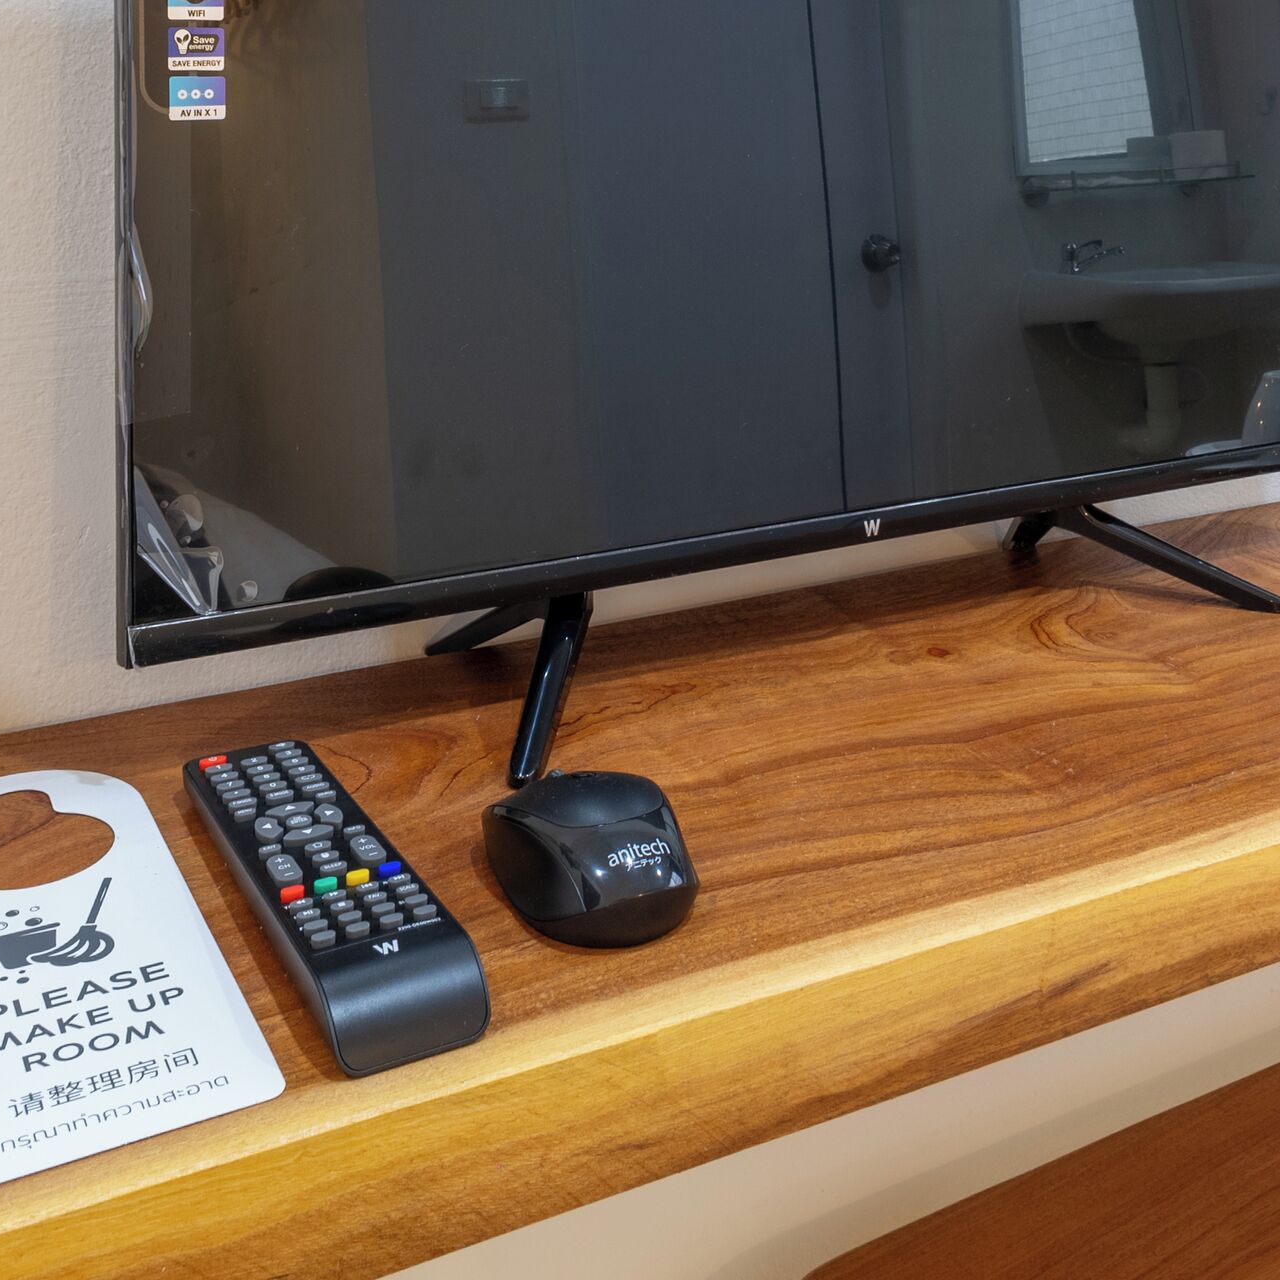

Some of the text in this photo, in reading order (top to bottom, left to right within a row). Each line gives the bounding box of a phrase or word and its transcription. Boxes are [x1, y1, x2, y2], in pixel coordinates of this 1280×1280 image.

[187, 9, 206, 17] WIFI
[188, 43, 215, 52] energy
[192, 35, 215, 44] Save
[192, 59, 221, 67] ENERGY
[180, 109, 192, 117] AV
[193, 109, 202, 117] IN
[863, 518, 881, 538] W
[358, 843, 377, 851] VOL
[607, 837, 671, 867] anitech
[372, 938, 400, 955] W
[127, 987, 185, 1013] UP
[21, 1020, 166, 1073] ROOM
[7, 1047, 200, 1118] 请整理房间
[0, 1074, 230, 1153] กรุณาทำความสะอาด
